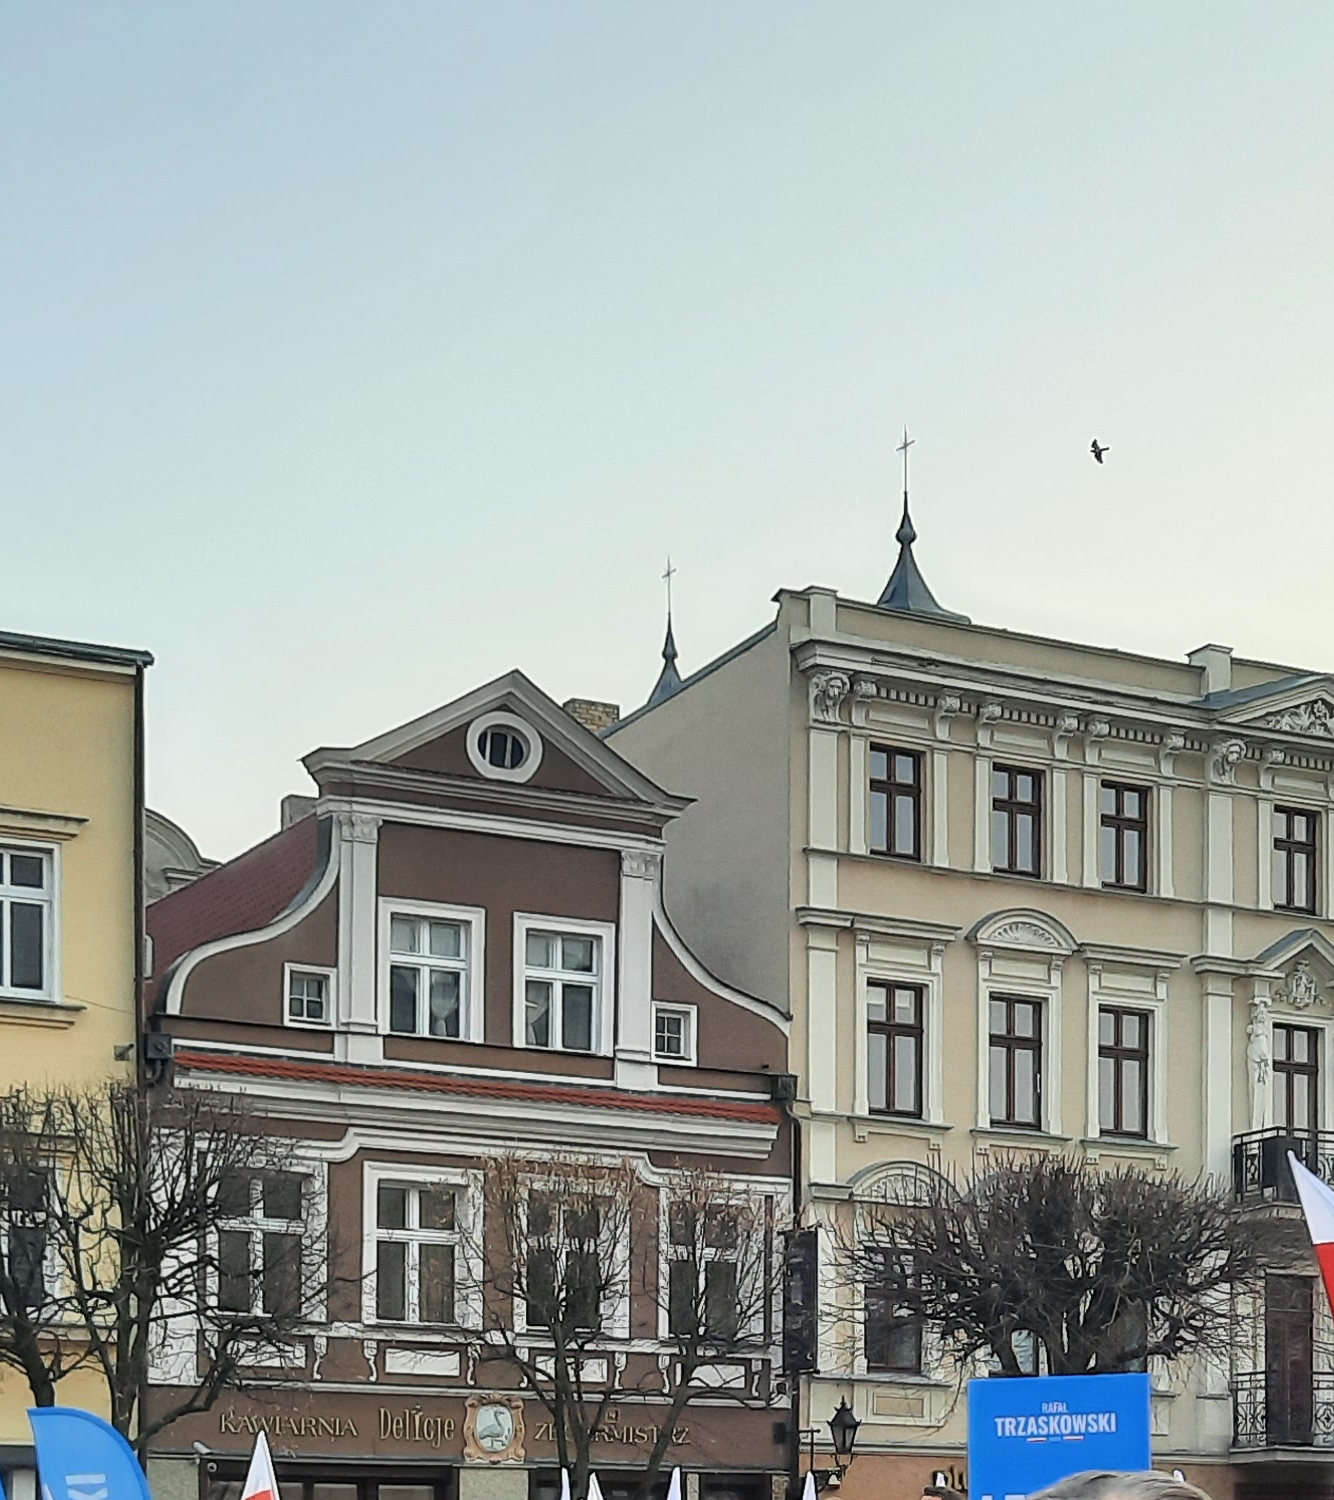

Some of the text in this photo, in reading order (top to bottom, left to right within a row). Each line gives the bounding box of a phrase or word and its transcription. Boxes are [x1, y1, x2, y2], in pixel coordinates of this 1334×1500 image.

[1041, 1401, 1069, 1414] RAFAŁ
[220, 1406, 455, 1448] KAWIARNIA Delicje
[994, 1412, 1117, 1437] TRZASKOWSKI
